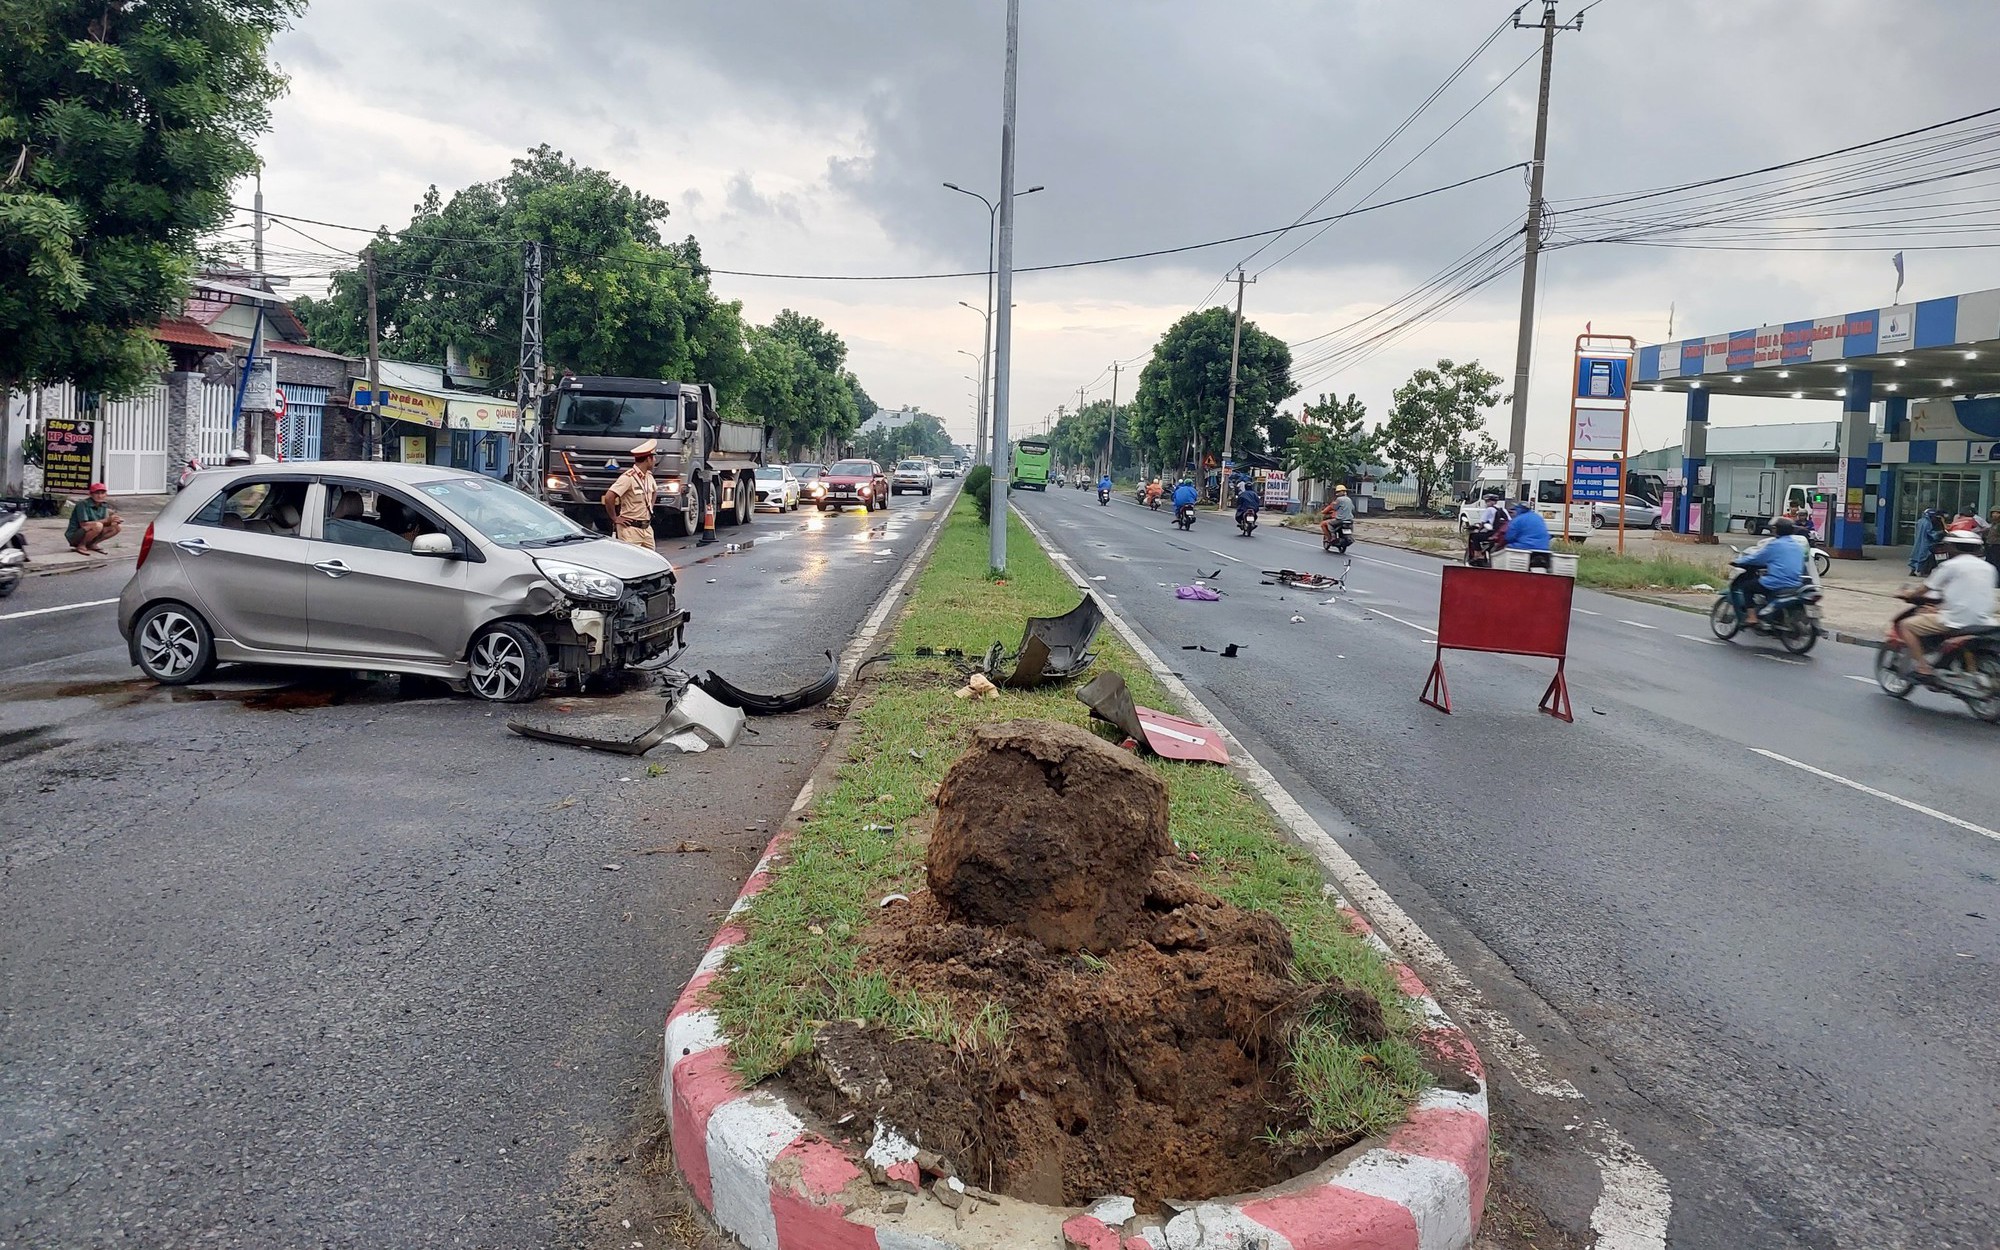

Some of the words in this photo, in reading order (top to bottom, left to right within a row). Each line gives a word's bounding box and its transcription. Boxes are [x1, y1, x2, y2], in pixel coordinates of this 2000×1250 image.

[411, 398, 424, 407] BA
[49, 421, 75, 431] Shop
[47, 431, 63, 441] HP
[64, 432, 93, 443] Sport
